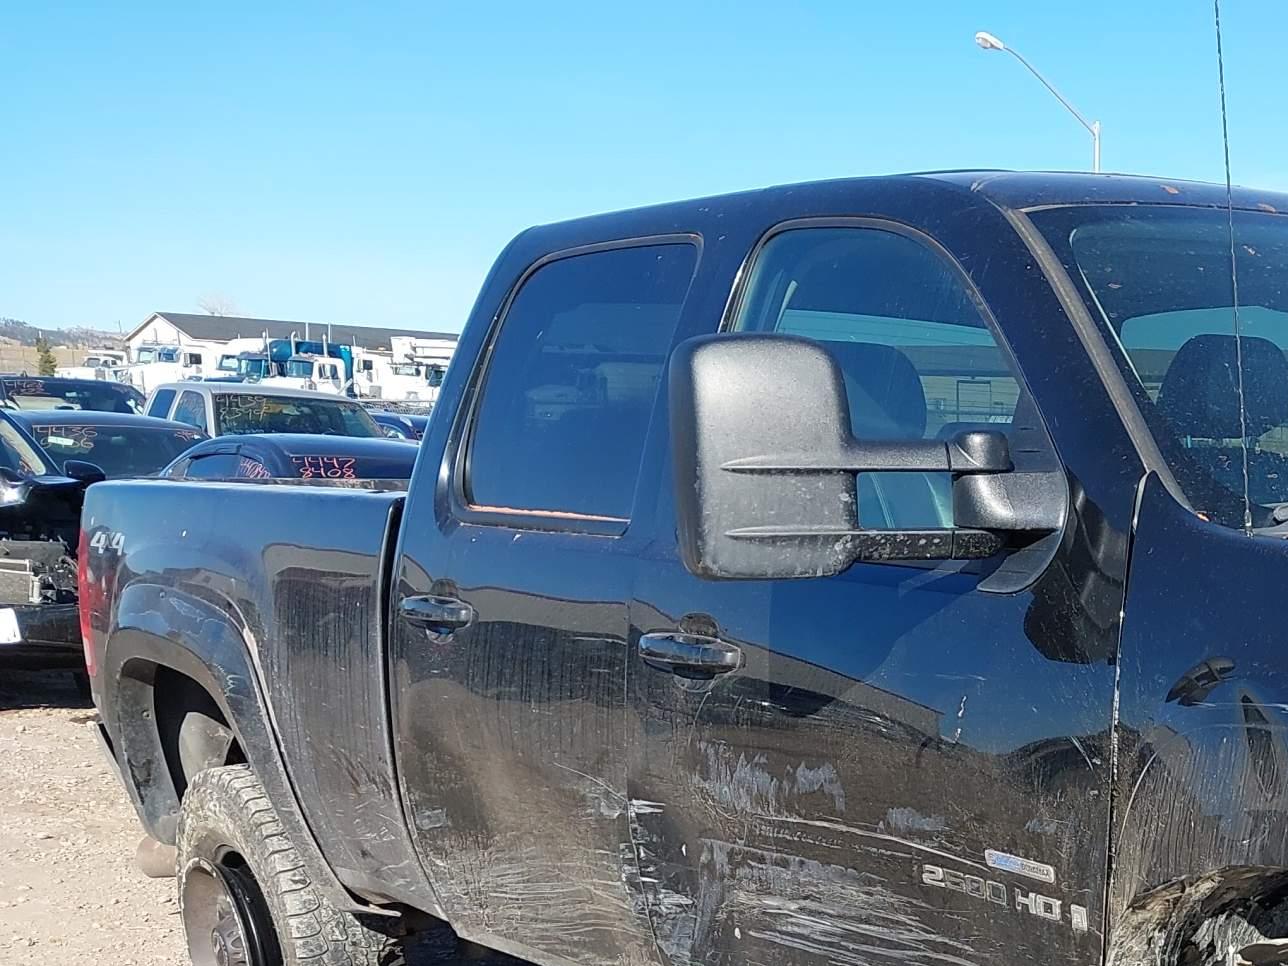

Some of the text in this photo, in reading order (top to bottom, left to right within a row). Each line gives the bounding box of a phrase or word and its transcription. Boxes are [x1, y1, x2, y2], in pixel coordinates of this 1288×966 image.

[292, 456, 356, 469] 4447
[300, 467, 356, 479] 8408
[922, 864, 1062, 921] 2500 HD
